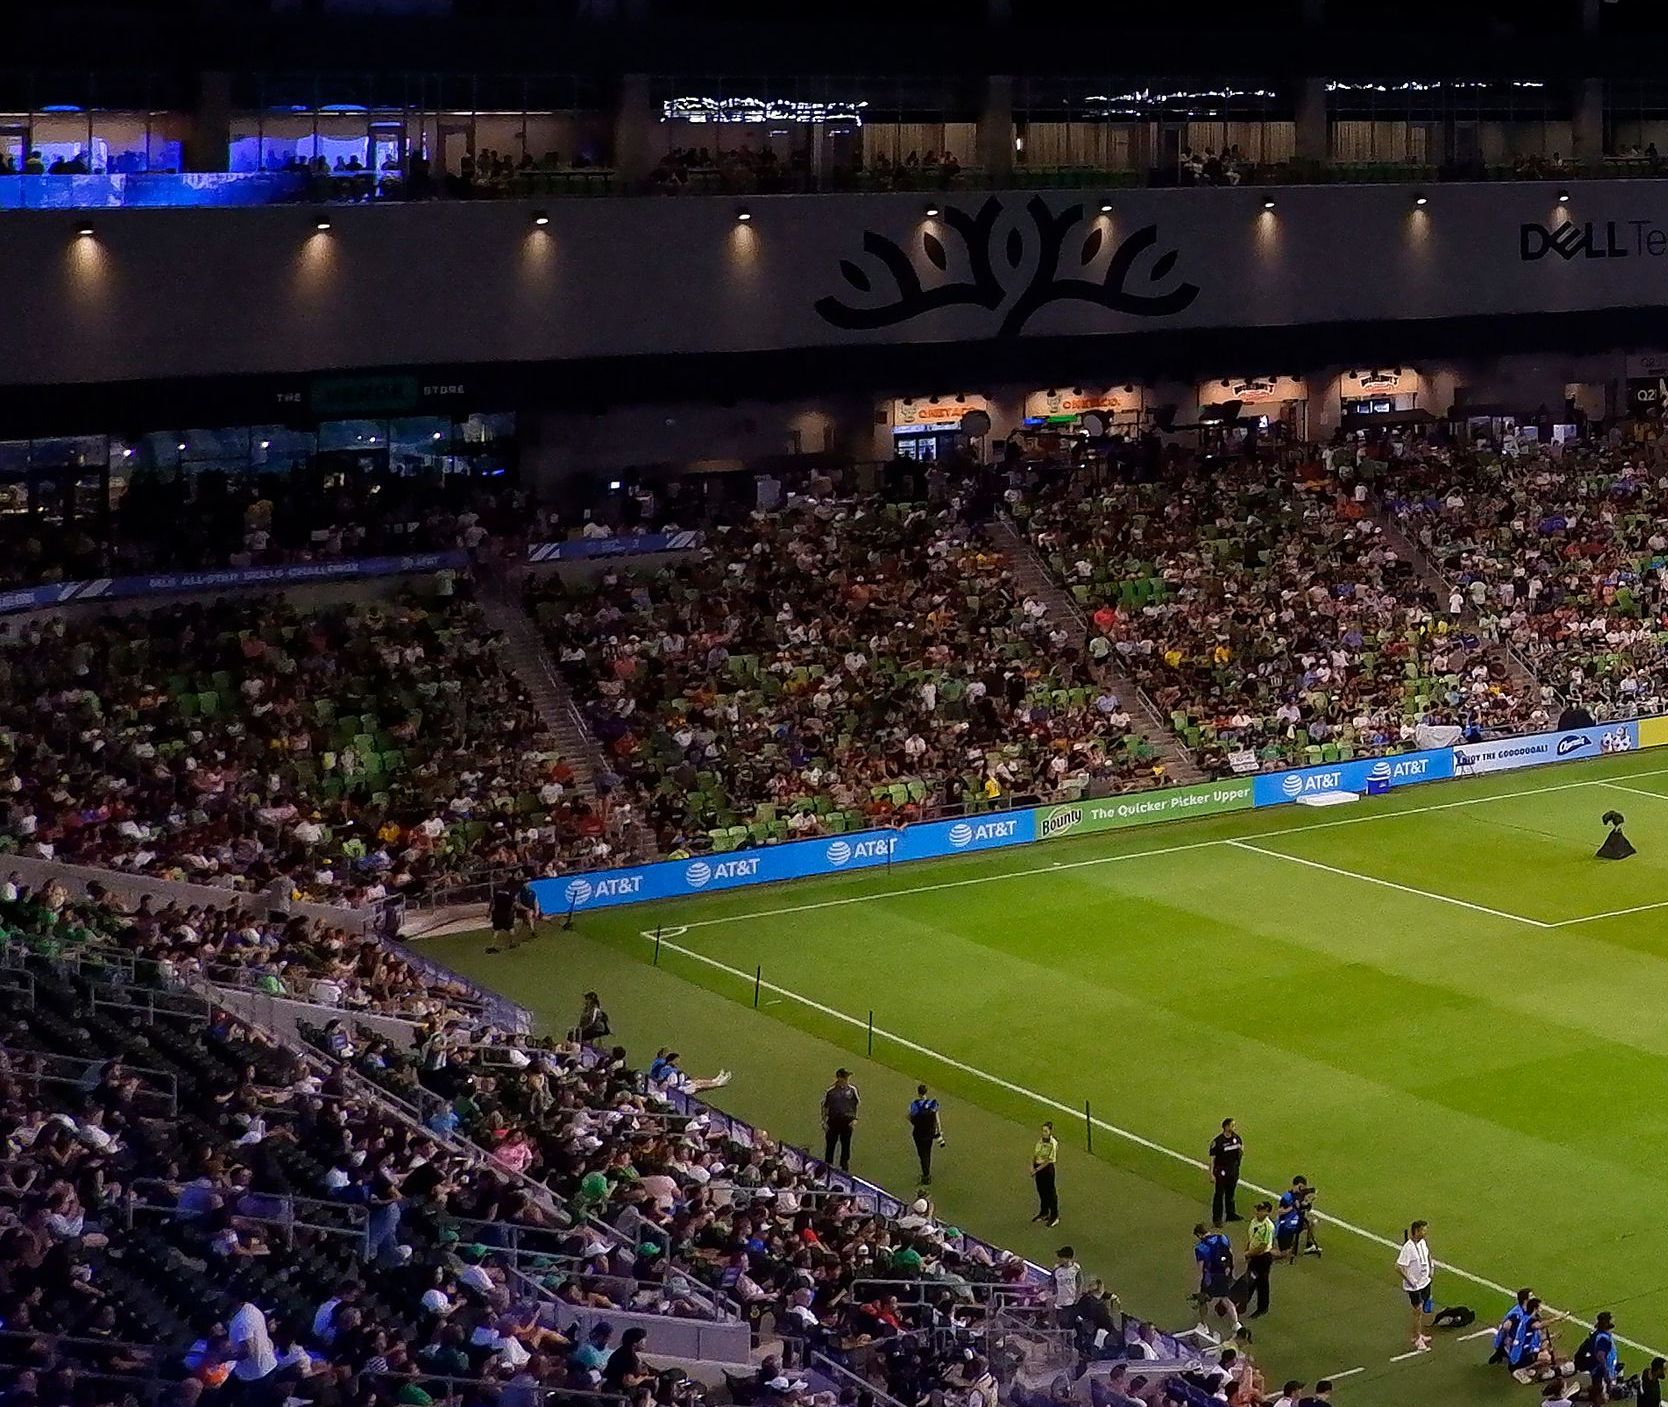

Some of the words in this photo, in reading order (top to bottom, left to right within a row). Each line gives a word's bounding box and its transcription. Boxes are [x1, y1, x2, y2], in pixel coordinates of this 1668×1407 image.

[1520, 220, 1627, 260] DELL
[1637, 390, 1655, 401] Q2
[1394, 759, 1429, 778] AT&T
[1305, 772, 1341, 791] AT&T
[1091, 808, 1115, 819] The
[1118, 800, 1167, 818] Quicker
[1170, 794, 1210, 808] Picker
[1213, 786, 1250, 804] Upper
[975, 821, 1017, 839] AT&T
[1040, 807, 1083, 837] Bounty
[855, 838, 896, 858] AT&T
[714, 858, 761, 880] AT&T
[595, 876, 643, 898] AT&T
